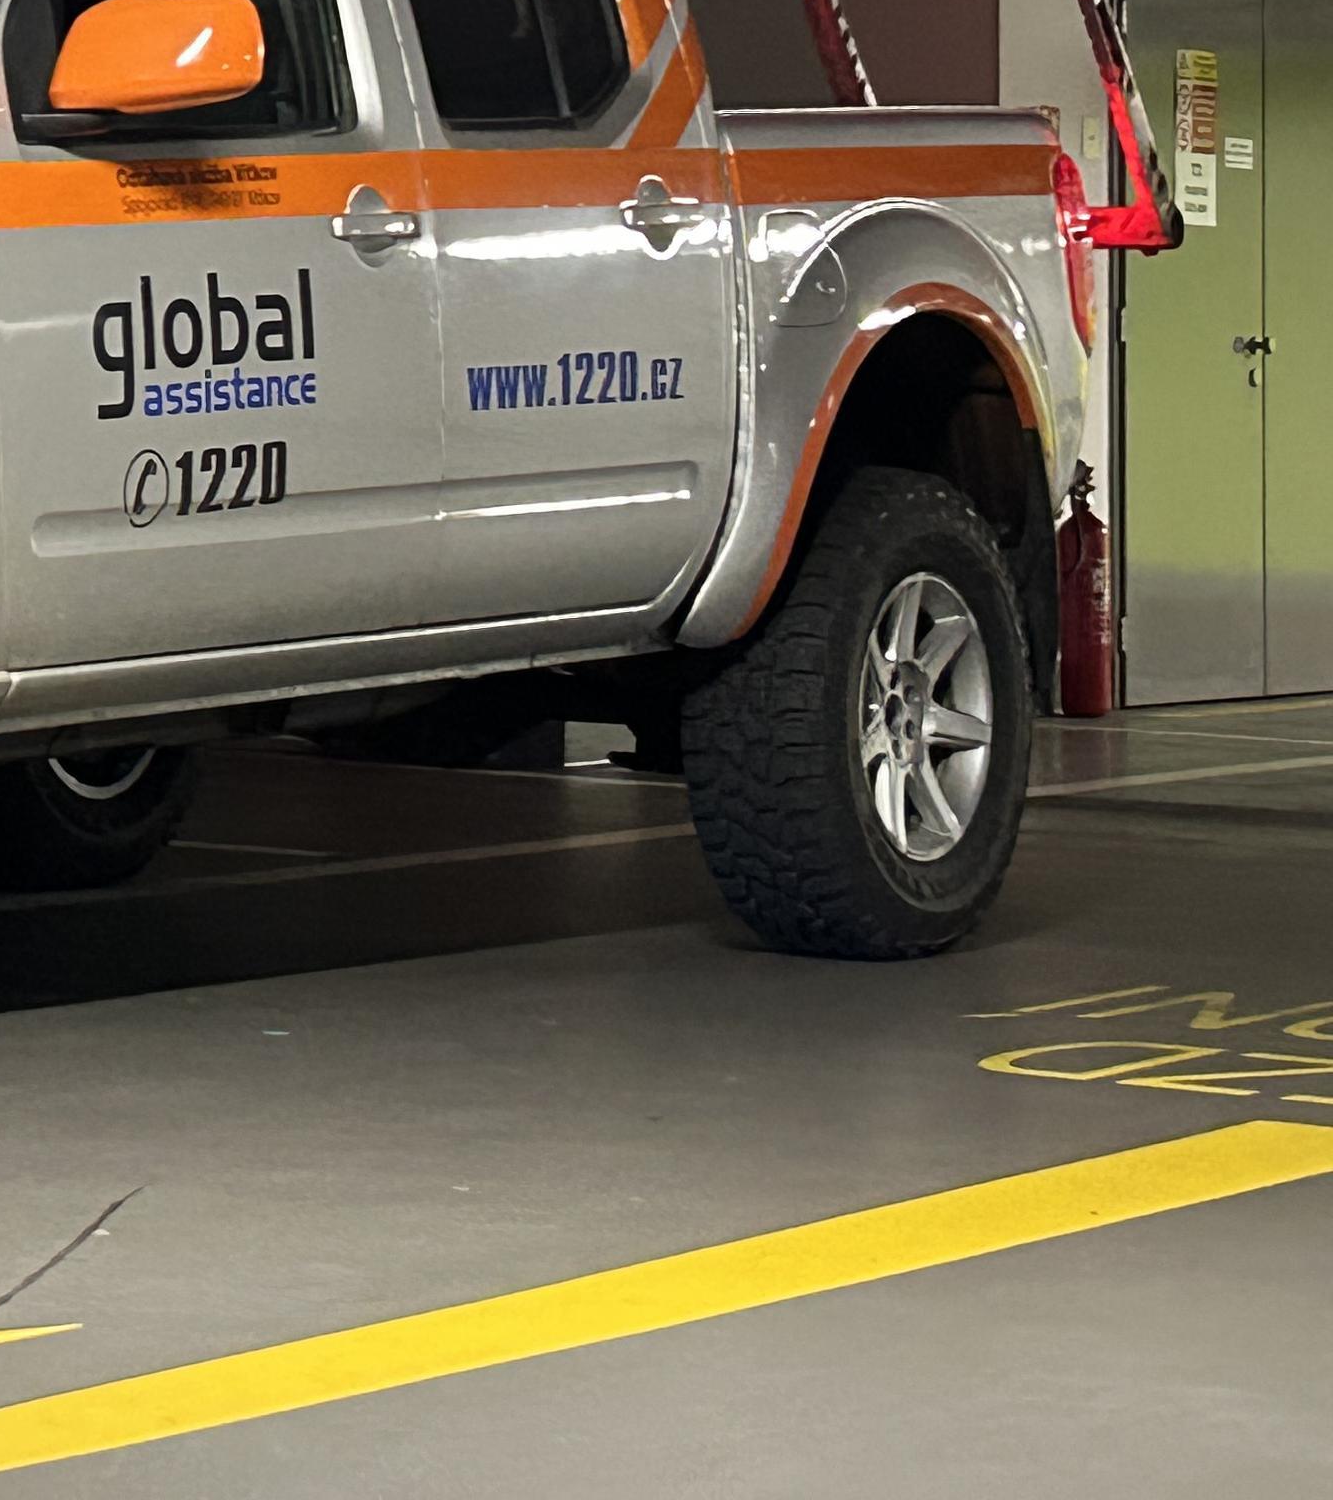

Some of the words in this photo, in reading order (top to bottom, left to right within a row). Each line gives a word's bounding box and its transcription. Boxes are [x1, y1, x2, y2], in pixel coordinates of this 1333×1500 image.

[92, 267, 316, 420] global
[143, 368, 317, 418] assistance
[467, 350, 685, 411] www.1220.cz
[175, 440, 288, 518] 1220
